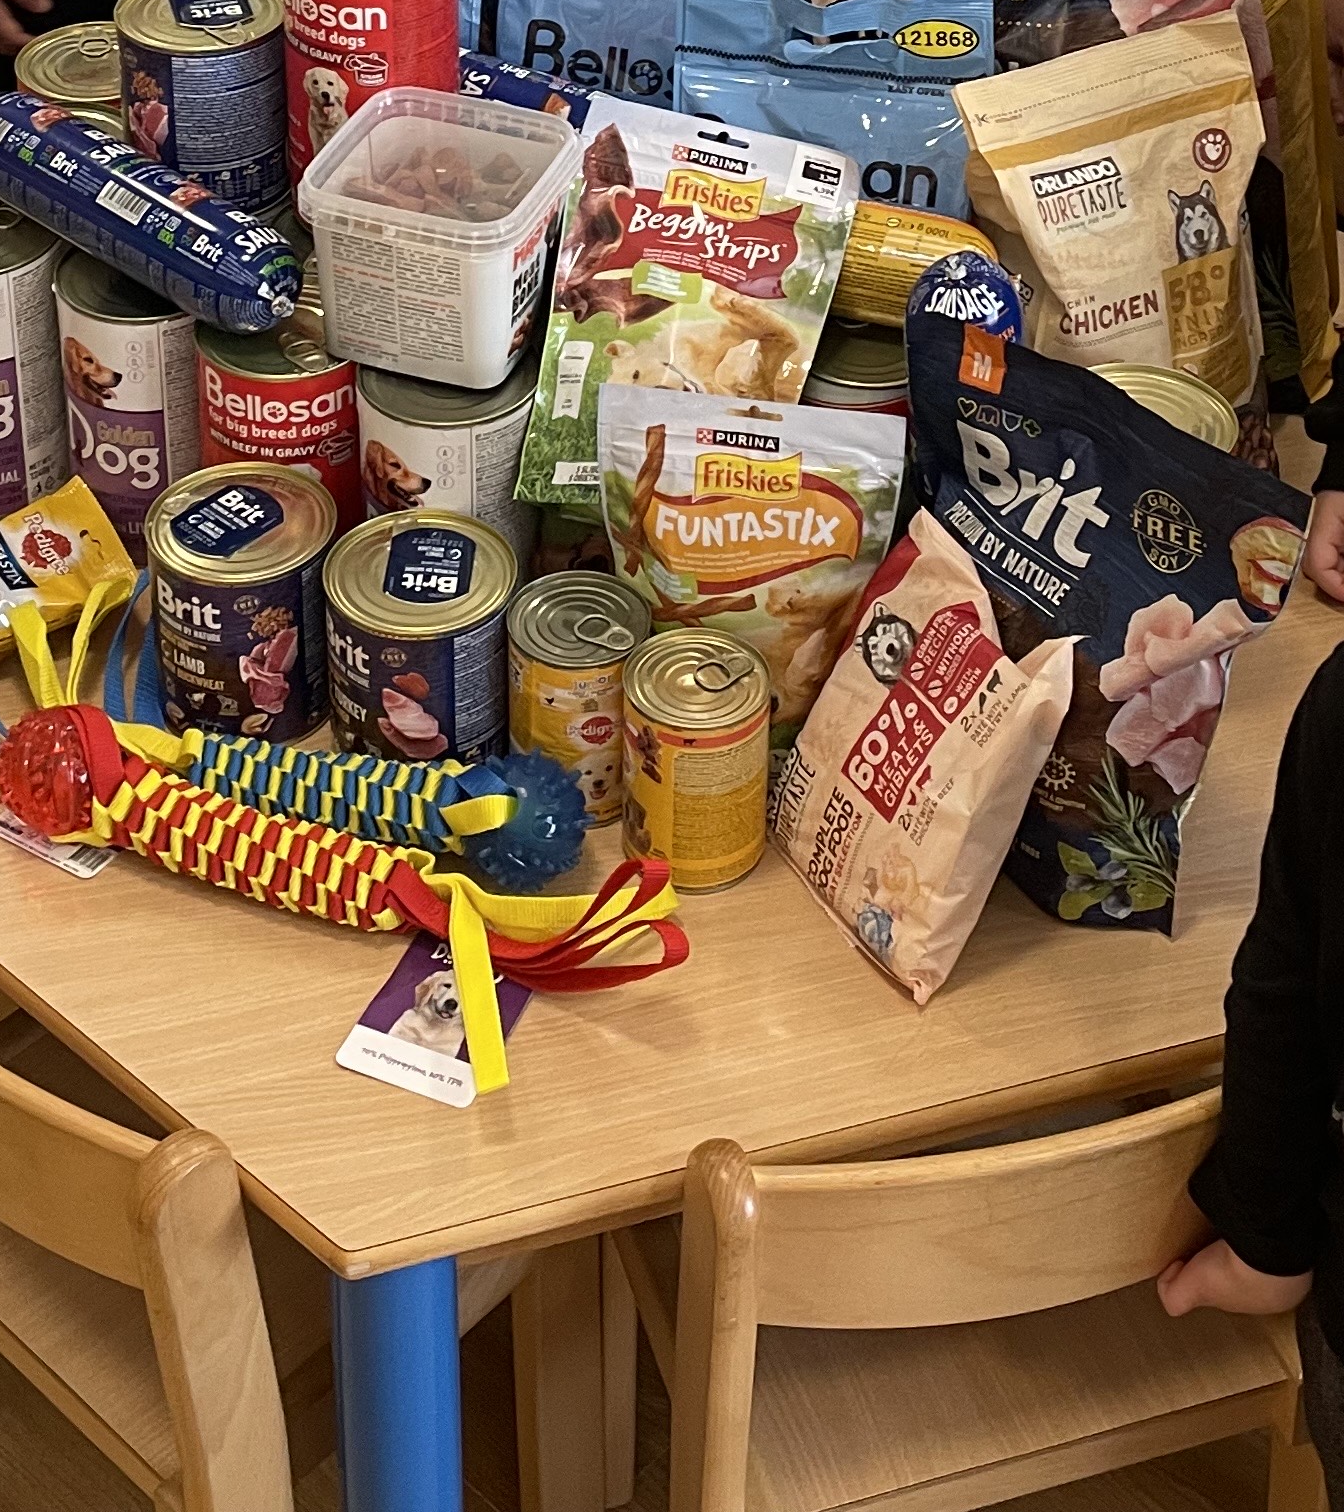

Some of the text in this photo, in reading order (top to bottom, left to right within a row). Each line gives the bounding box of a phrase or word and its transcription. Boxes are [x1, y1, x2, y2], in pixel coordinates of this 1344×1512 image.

[191, 4, 244, 19] Brit
[309, 47, 344, 64] GRAVY
[329, 30, 366, 51] dogs
[898, 31, 974, 48] 121868
[917, 88, 945, 98] OPEN
[49, 151, 80, 178] Brit
[689, 149, 746, 173] PURINA
[1033, 160, 1117, 197] ORLANDO
[670, 175, 755, 214] Friskies
[1037, 177, 1127, 230] PURETASTE
[628, 203, 734, 239] Beggin'
[191, 234, 223, 263] Brit
[700, 235, 782, 269] Strips
[925, 283, 1005, 321] SAUSAGE
[1059, 289, 1159, 336] CHICKEN
[972, 352, 993, 382] M
[205, 366, 355, 423] Bellosan
[68, 397, 160, 489] Dog
[96, 420, 155, 447] Golden
[226, 415, 249, 439] big
[252, 422, 297, 440] breed
[301, 418, 339, 440] dogs
[715, 431, 778, 450] PURINA
[232, 440, 258, 455] BEEF
[261, 445, 274, 457] IN
[276, 443, 316, 458] GRAVY
[703, 459, 795, 494] Friskies
[956, 419, 1110, 568] Brit
[217, 490, 265, 524] Brit
[1147, 494, 1181, 515] GMO
[23, 512, 71, 576] Pedigree
[655, 505, 841, 548] FUNTASTIX
[1132, 511, 1204, 556] FREE
[979, 530, 1006, 561] BY
[1004, 546, 1071, 607] NATURE
[1149, 550, 1179, 568] SOY
[401, 573, 459, 594] Brit
[157, 575, 222, 630] Brit
[173, 649, 206, 675] LAMB
[936, 623, 974, 676] WITHOUT
[960, 711, 978, 733] 2x
[848, 699, 919, 792] 60%
[874, 718, 927, 798] MEAT &
[884, 727, 934, 808] GIBLETS
[828, 799, 854, 859] FOOD
[834, 811, 863, 880] SELECTION
